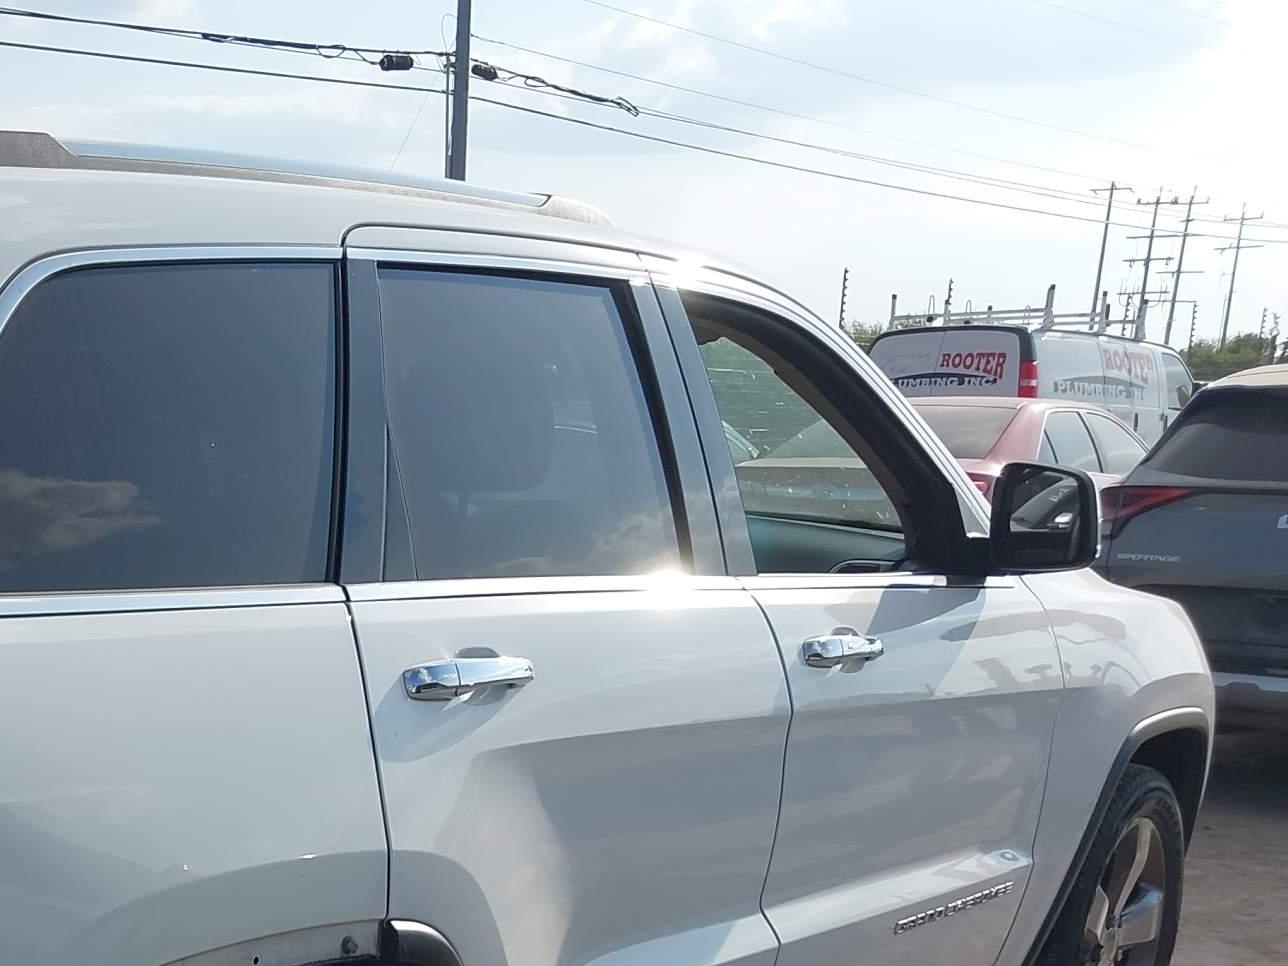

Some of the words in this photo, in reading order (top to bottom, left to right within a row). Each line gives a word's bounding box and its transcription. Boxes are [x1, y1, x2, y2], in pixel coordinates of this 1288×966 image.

[939, 352, 1007, 379] ROOTER
[1103, 349, 1153, 384] ROOTER
[1056, 380, 1127, 399] PLUMBING
[1116, 553, 1181, 562] SPORTAGE
